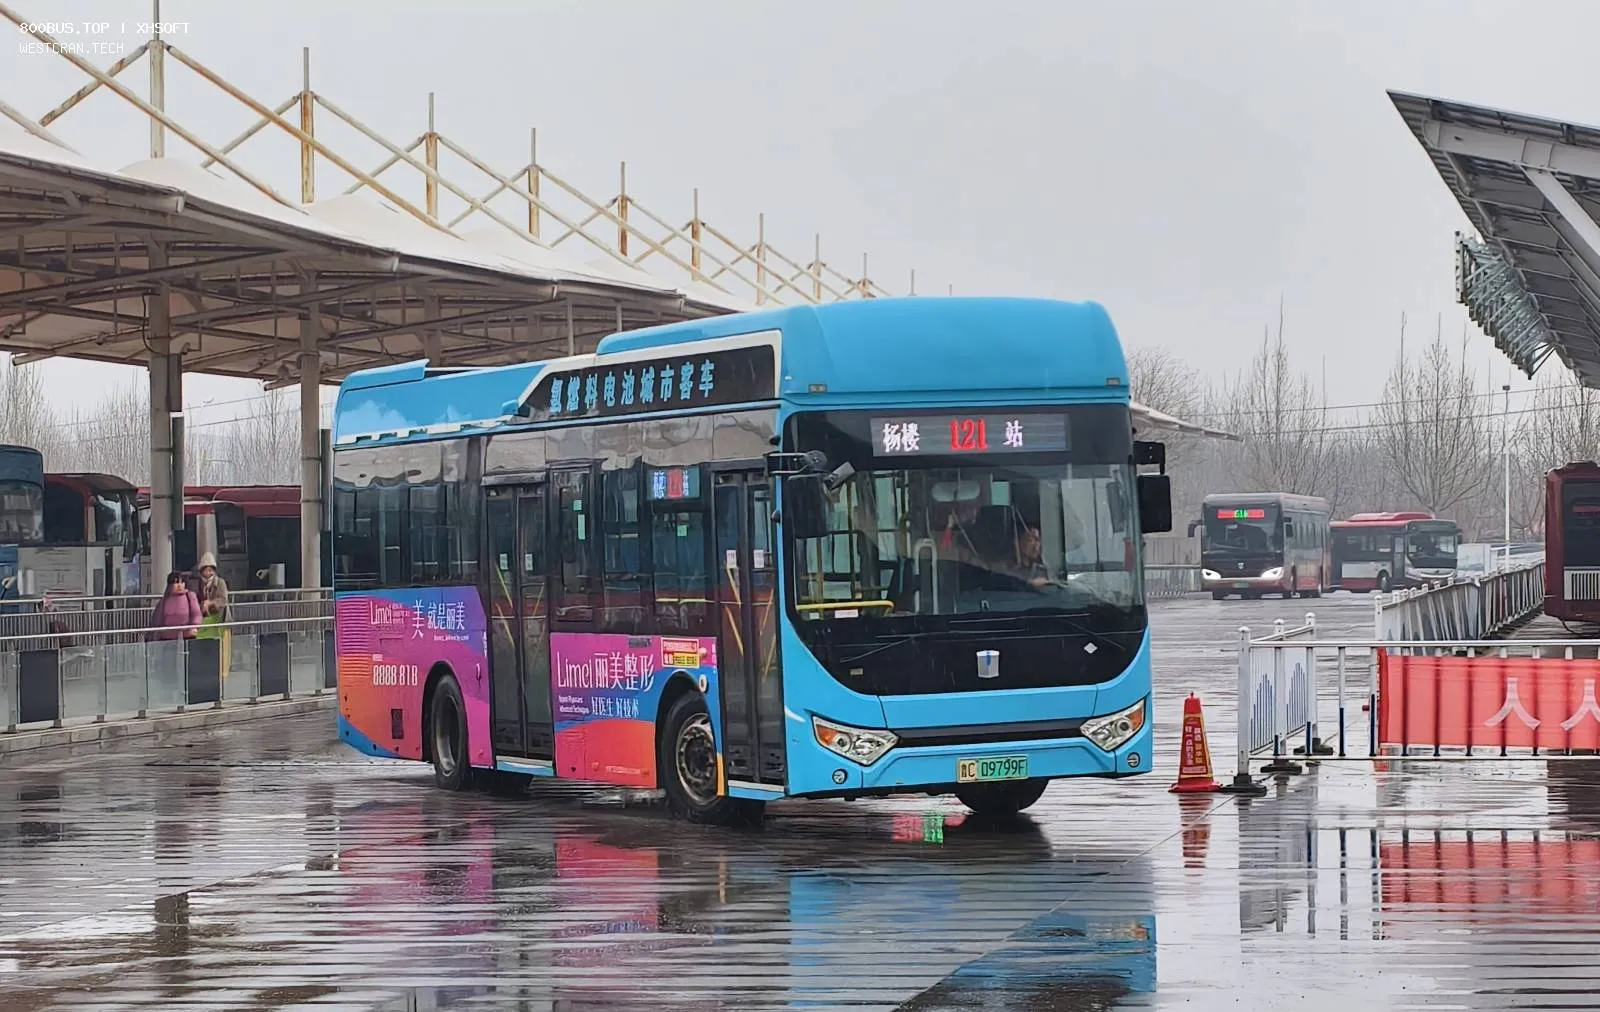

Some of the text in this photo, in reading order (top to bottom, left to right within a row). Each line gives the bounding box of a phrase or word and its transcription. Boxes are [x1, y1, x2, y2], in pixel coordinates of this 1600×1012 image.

[882, 418, 1023, 452] 杨楼 121 站
[370, 601, 392, 625] Limei
[557, 652, 655, 692] Limei 丽美整形
